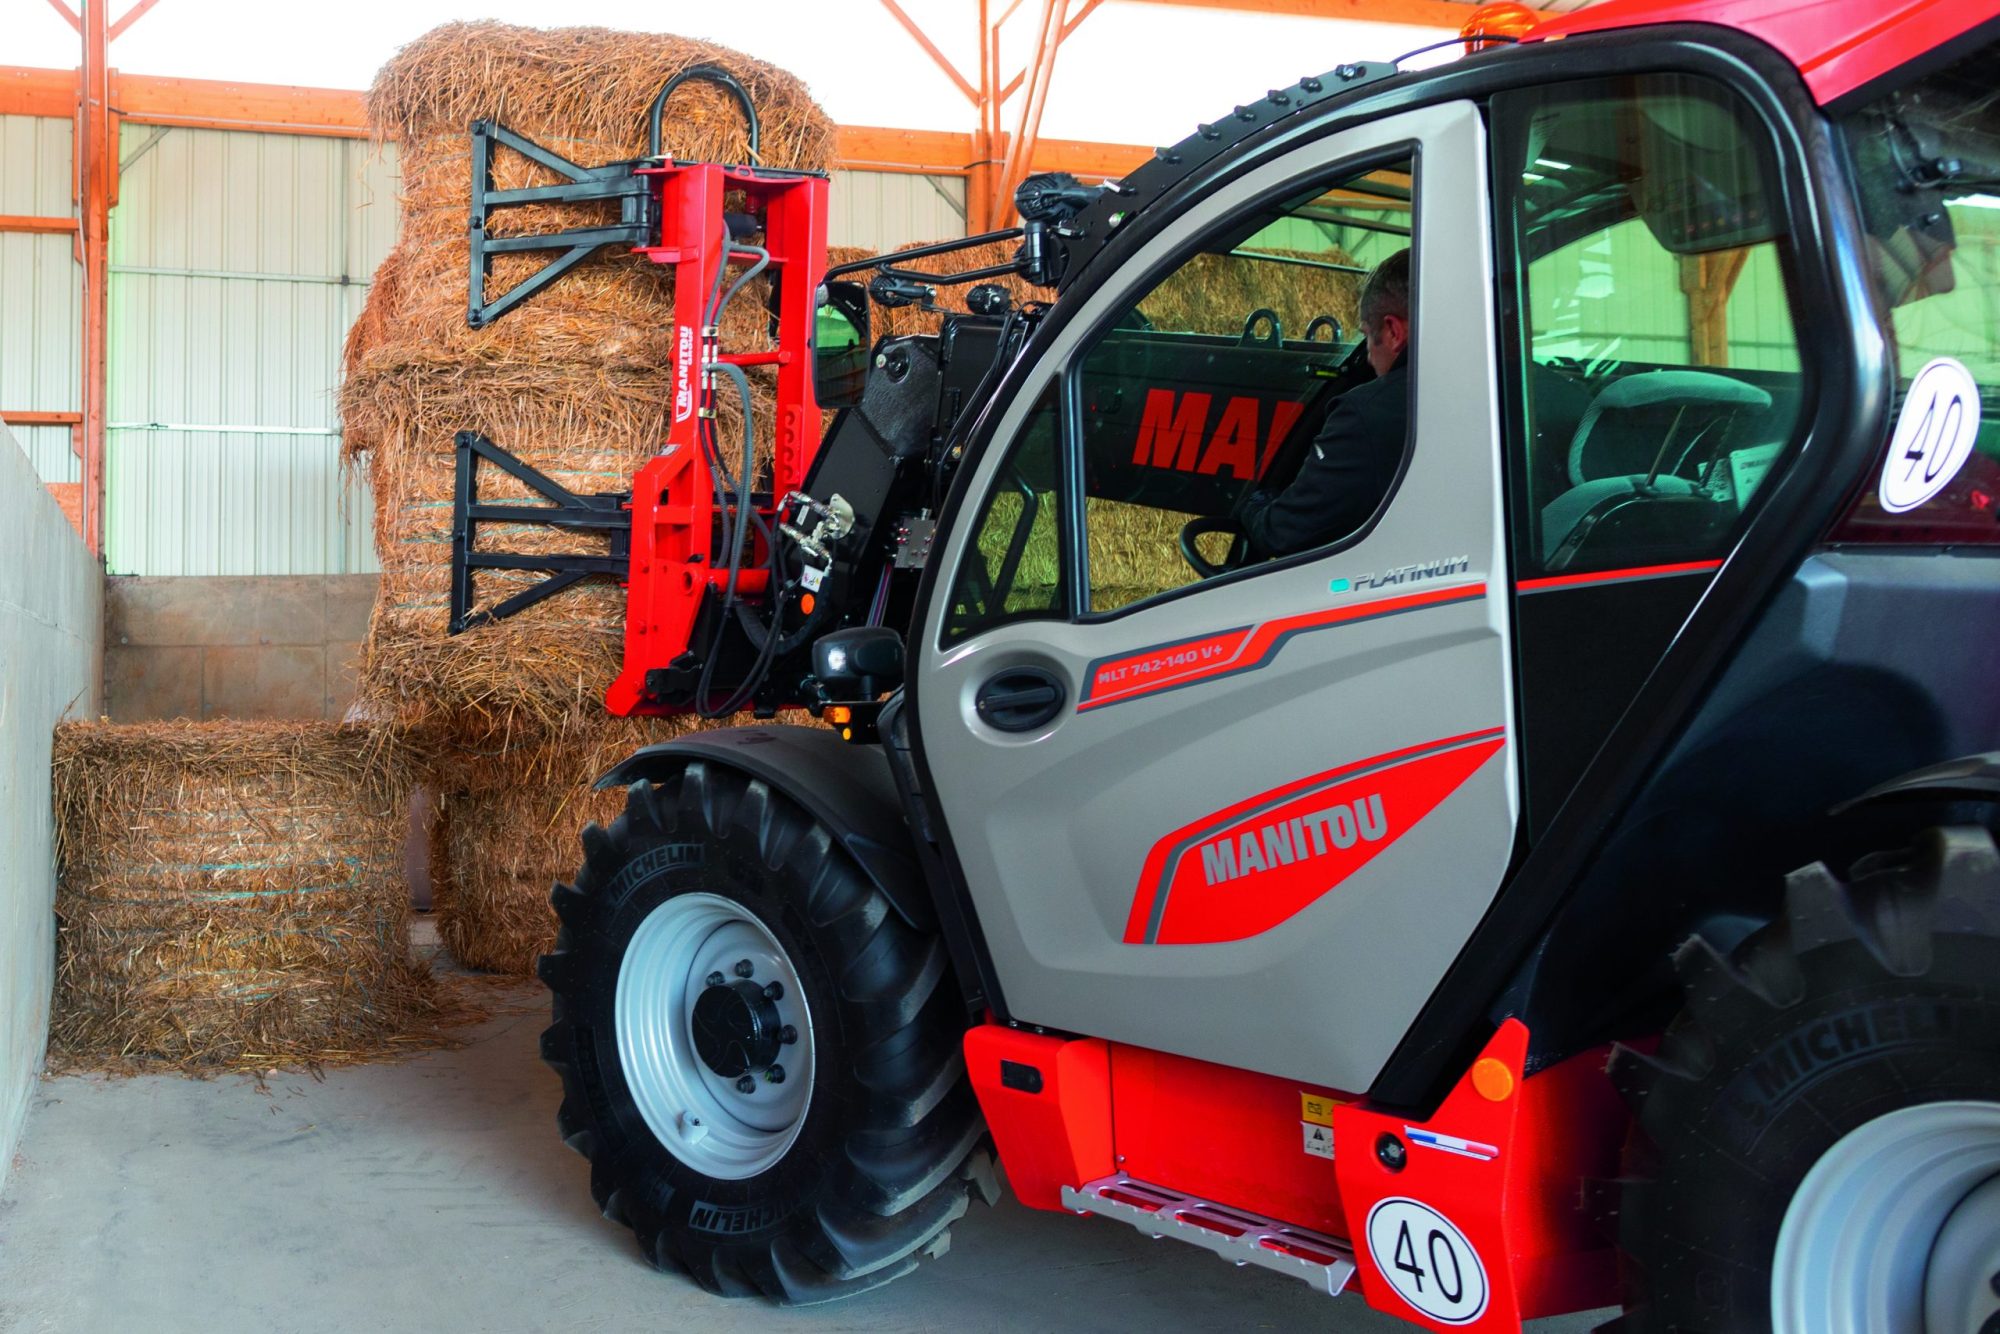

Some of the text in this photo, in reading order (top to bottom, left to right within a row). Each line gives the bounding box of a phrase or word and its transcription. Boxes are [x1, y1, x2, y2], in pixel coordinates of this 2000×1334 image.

[679, 326, 689, 407] MANITOU
[1904, 391, 1963, 484] 40
[1354, 554, 1469, 592] PLATINUM
[1098, 644, 1223, 684] MLT 742-140 V+
[609, 846, 701, 903] MICHELIN
[1201, 793, 1388, 887] MANITOU
[1394, 1219, 1463, 1305] 40
